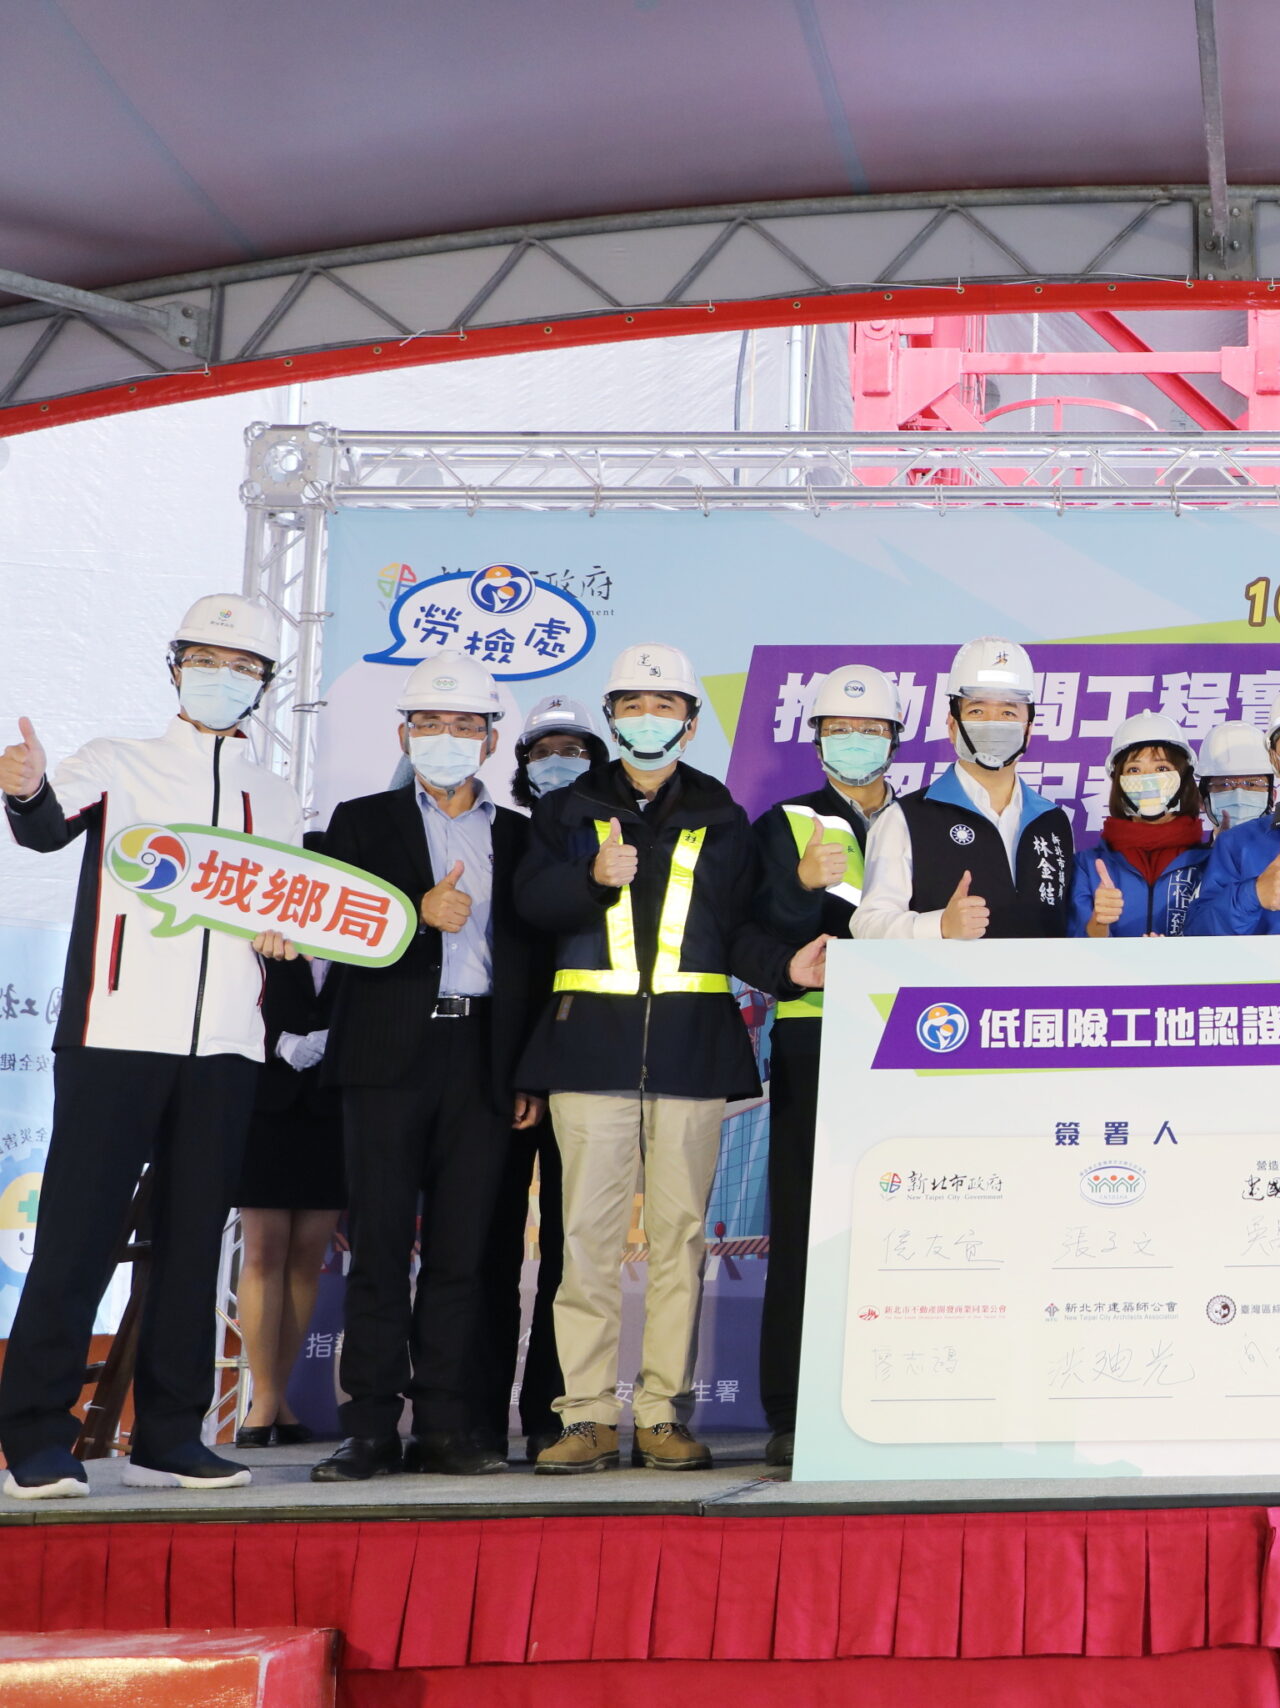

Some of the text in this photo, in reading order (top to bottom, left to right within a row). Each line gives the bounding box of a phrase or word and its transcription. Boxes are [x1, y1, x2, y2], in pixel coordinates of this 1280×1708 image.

[413, 604, 571, 664] 勞檢處
[1033, 834, 1056, 906] 林金結
[191, 850, 391, 947] 城鄉局
[1055, 1120, 1178, 1146] 簽署人
[907, 1170, 1003, 1193] 新北市政府
[1065, 1301, 1178, 1314] 新北市建築師公會
